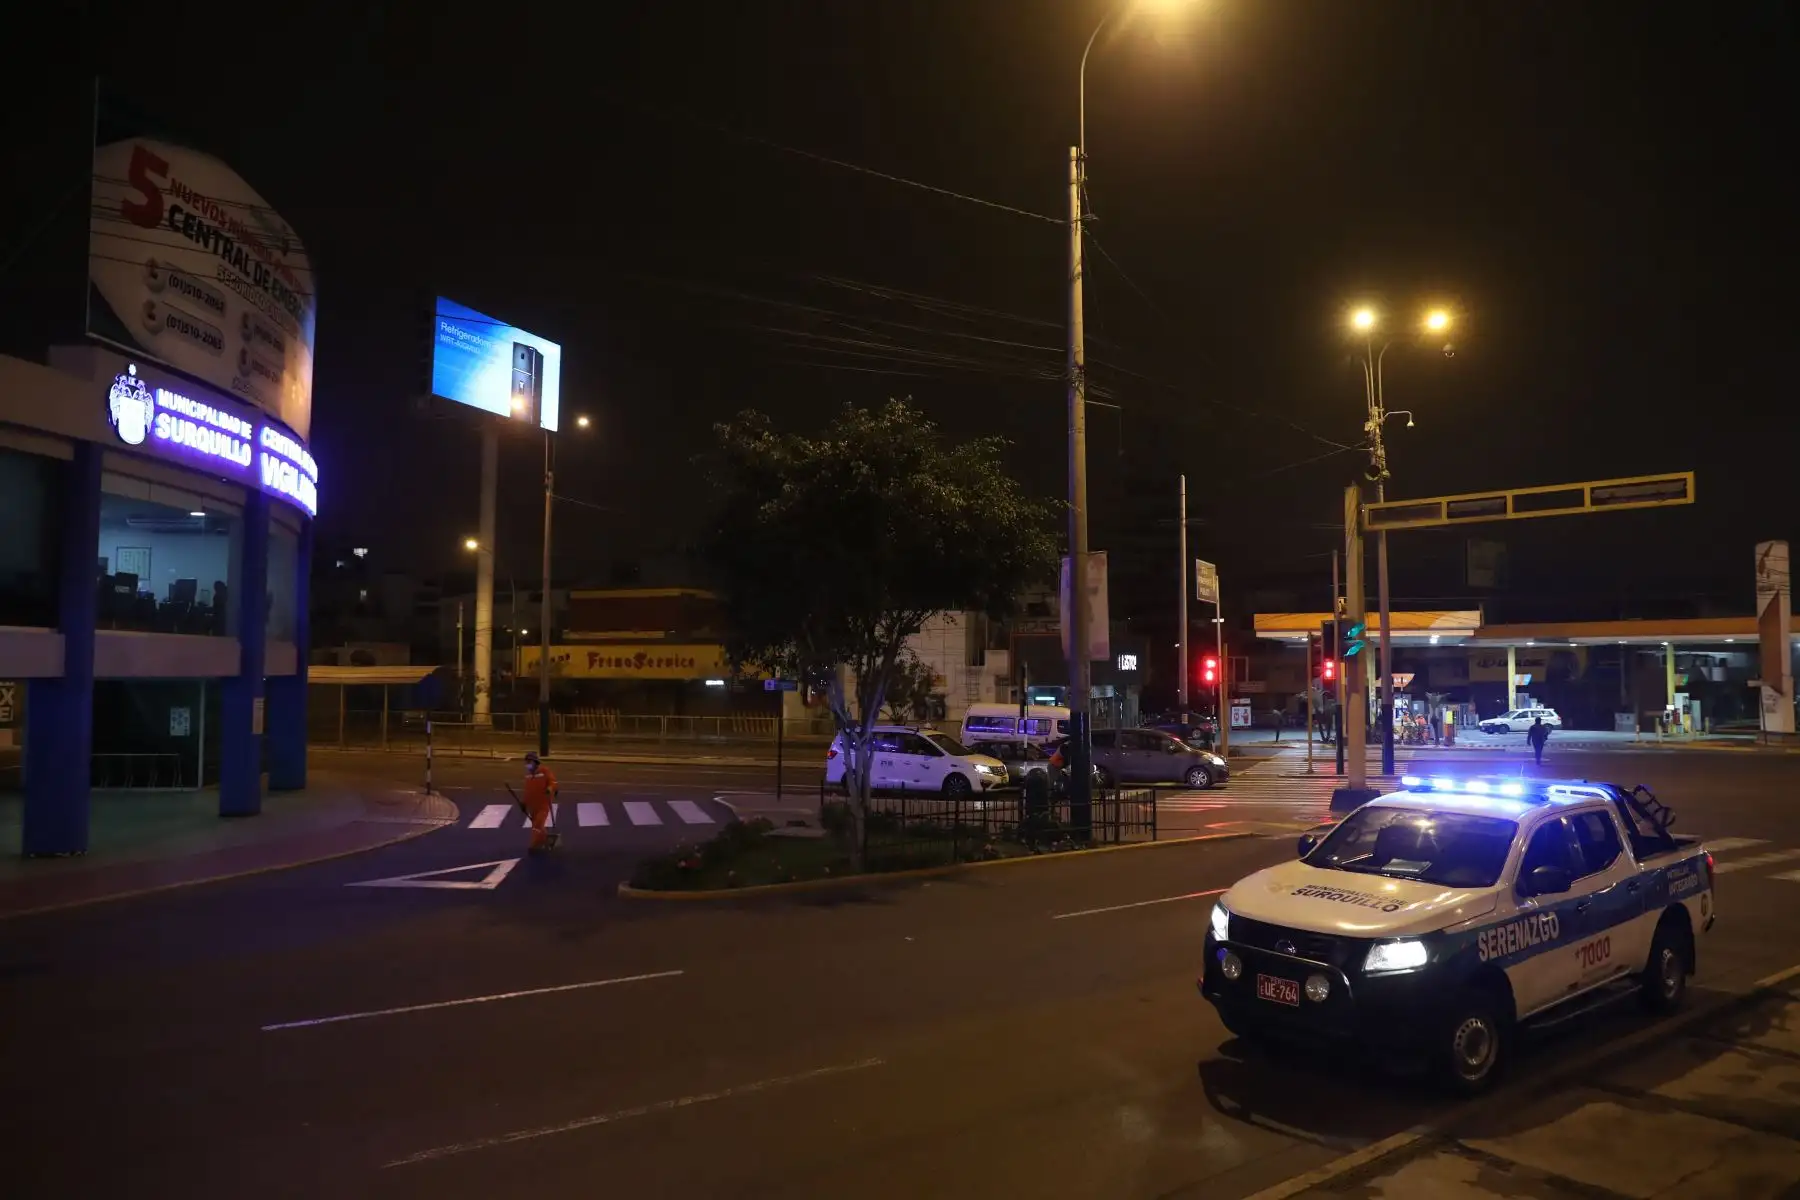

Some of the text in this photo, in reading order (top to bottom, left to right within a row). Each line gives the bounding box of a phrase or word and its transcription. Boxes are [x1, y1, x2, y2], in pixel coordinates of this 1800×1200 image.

[120, 144, 169, 229] 5
[170, 177, 228, 227] NUEVOS
[168, 204, 251, 278] CENTRAL
[253, 261, 272, 293] DE
[157, 388, 241, 434] MUNICIPALIDAD
[156, 412, 252, 467] SURQUILLO
[1291, 887, 1400, 913] SURQUILLO
[1478, 911, 1560, 962] SERENAZGO
